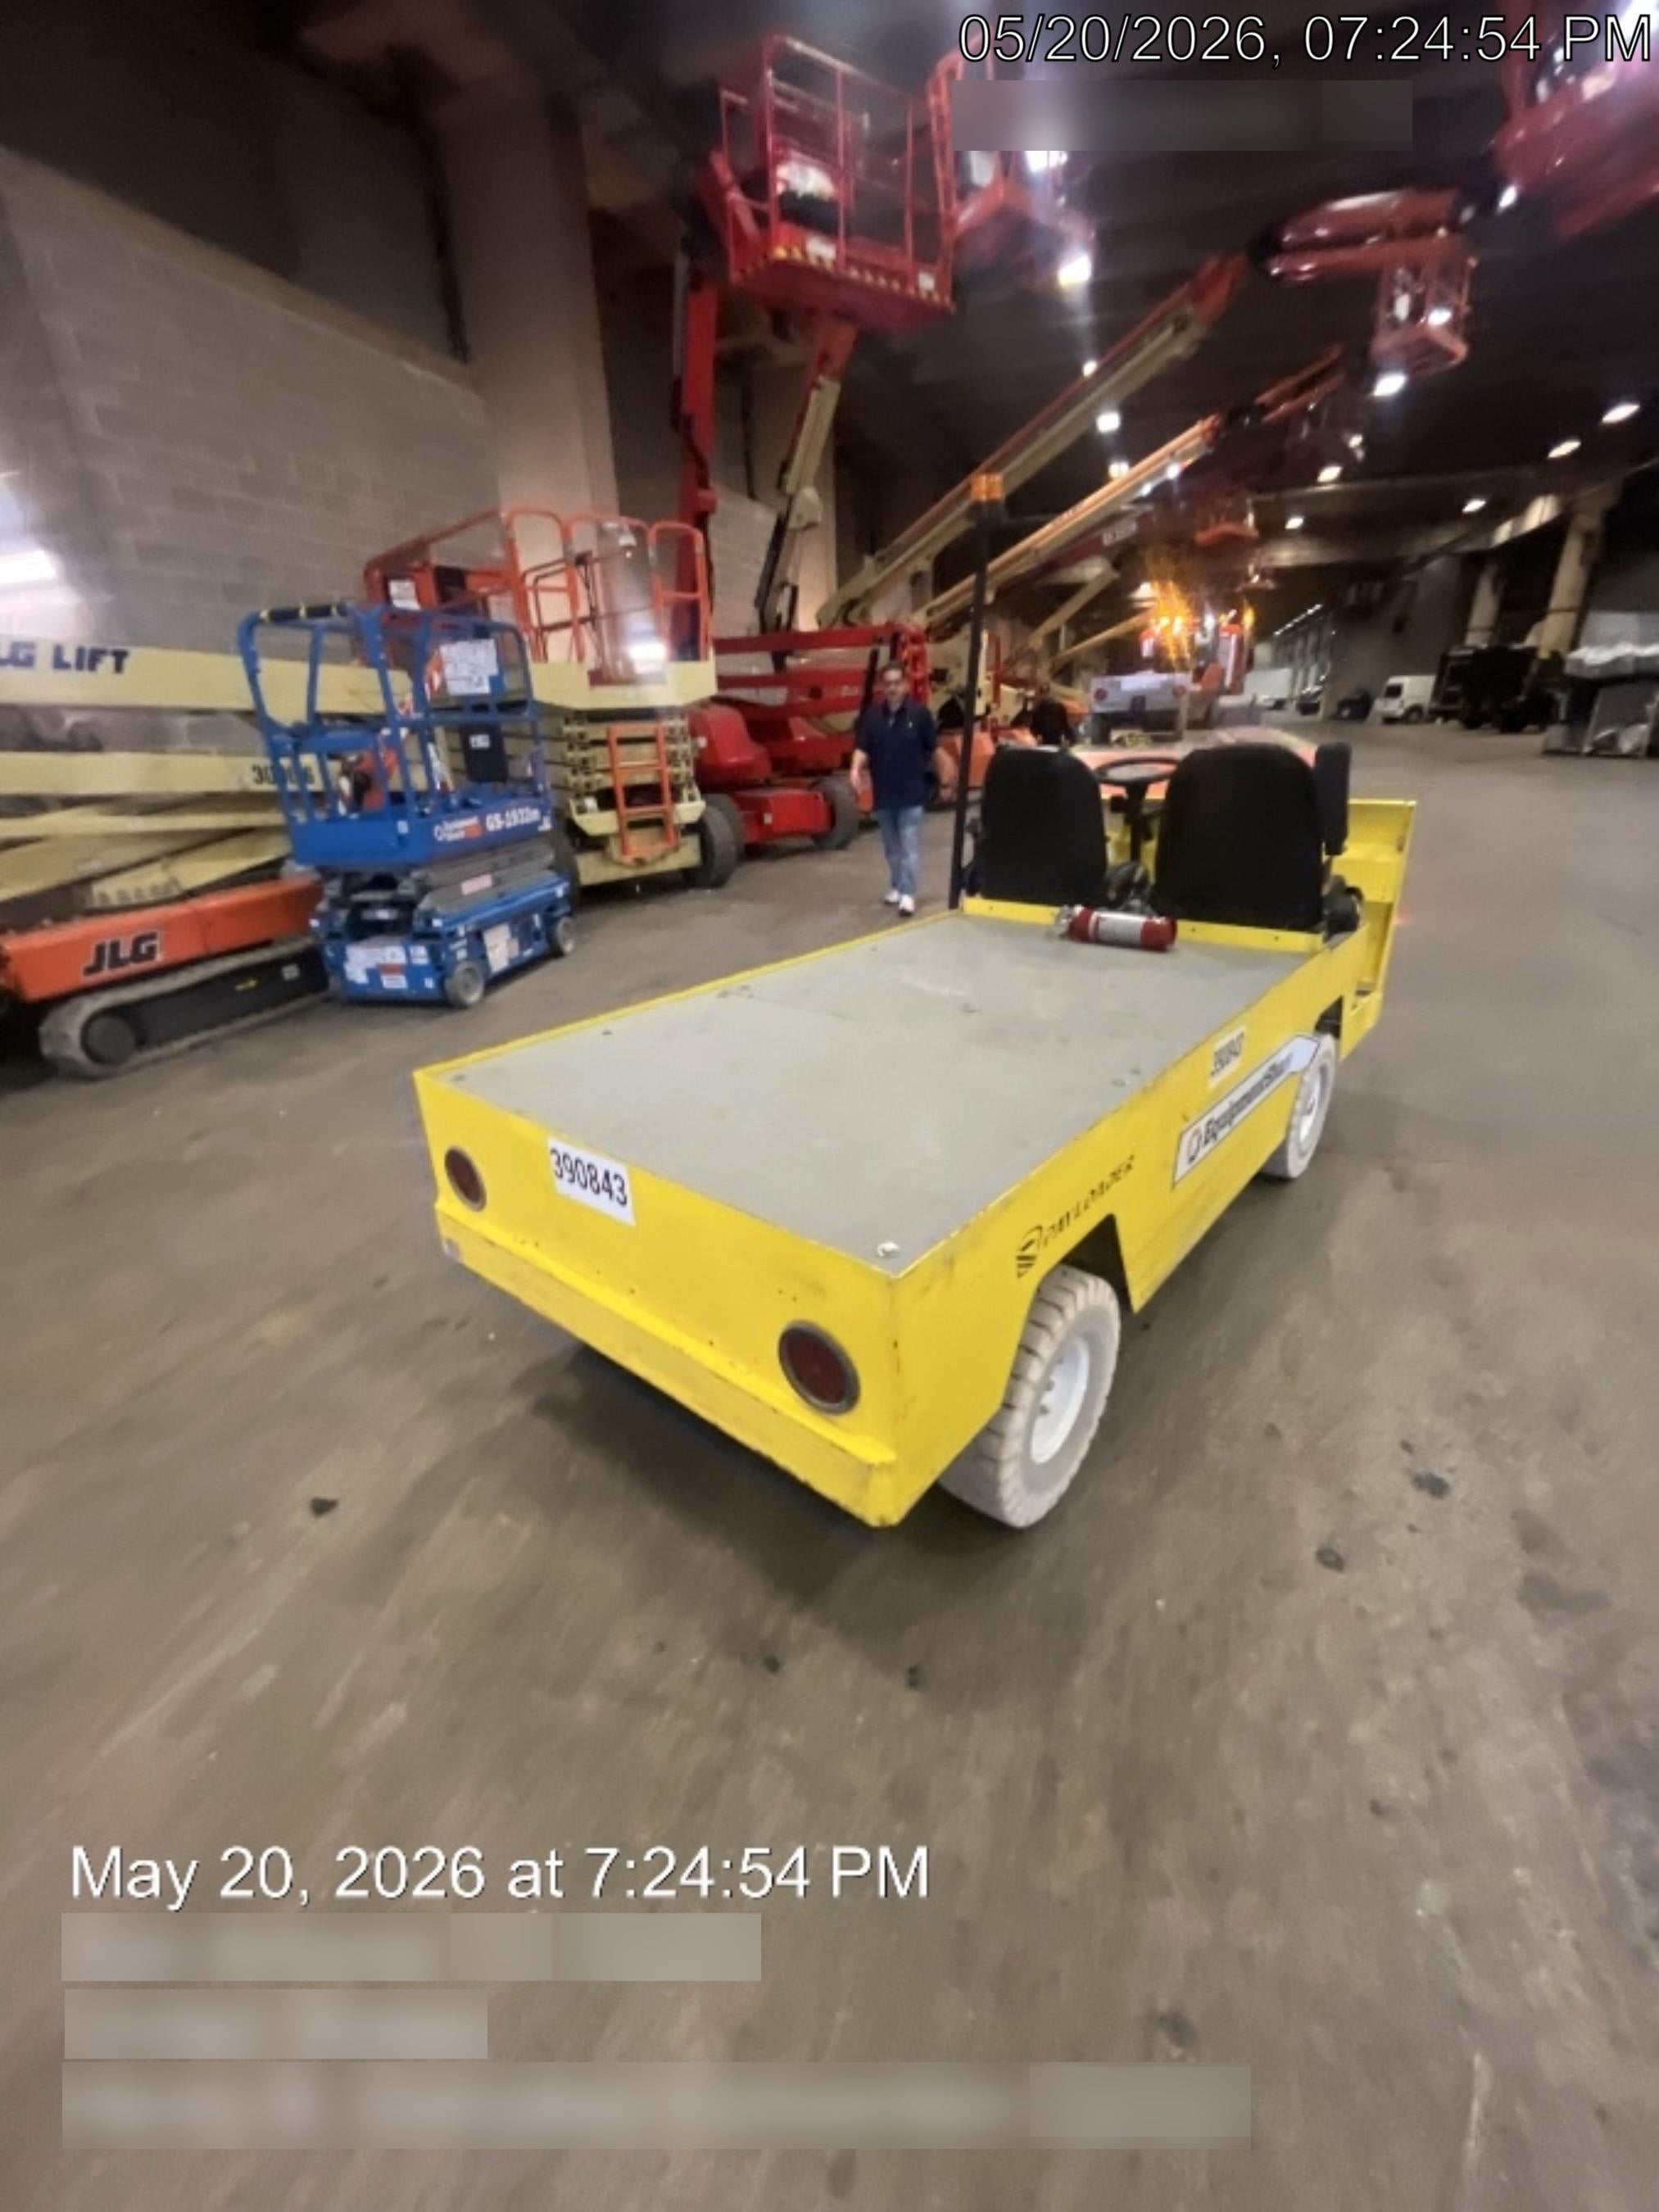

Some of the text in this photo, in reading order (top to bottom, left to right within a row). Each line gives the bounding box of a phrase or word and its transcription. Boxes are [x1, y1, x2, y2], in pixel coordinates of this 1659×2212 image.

[52, 643, 129, 674] LIFT
[82, 931, 158, 977] JLG
[550, 1147, 628, 1207] 390843
